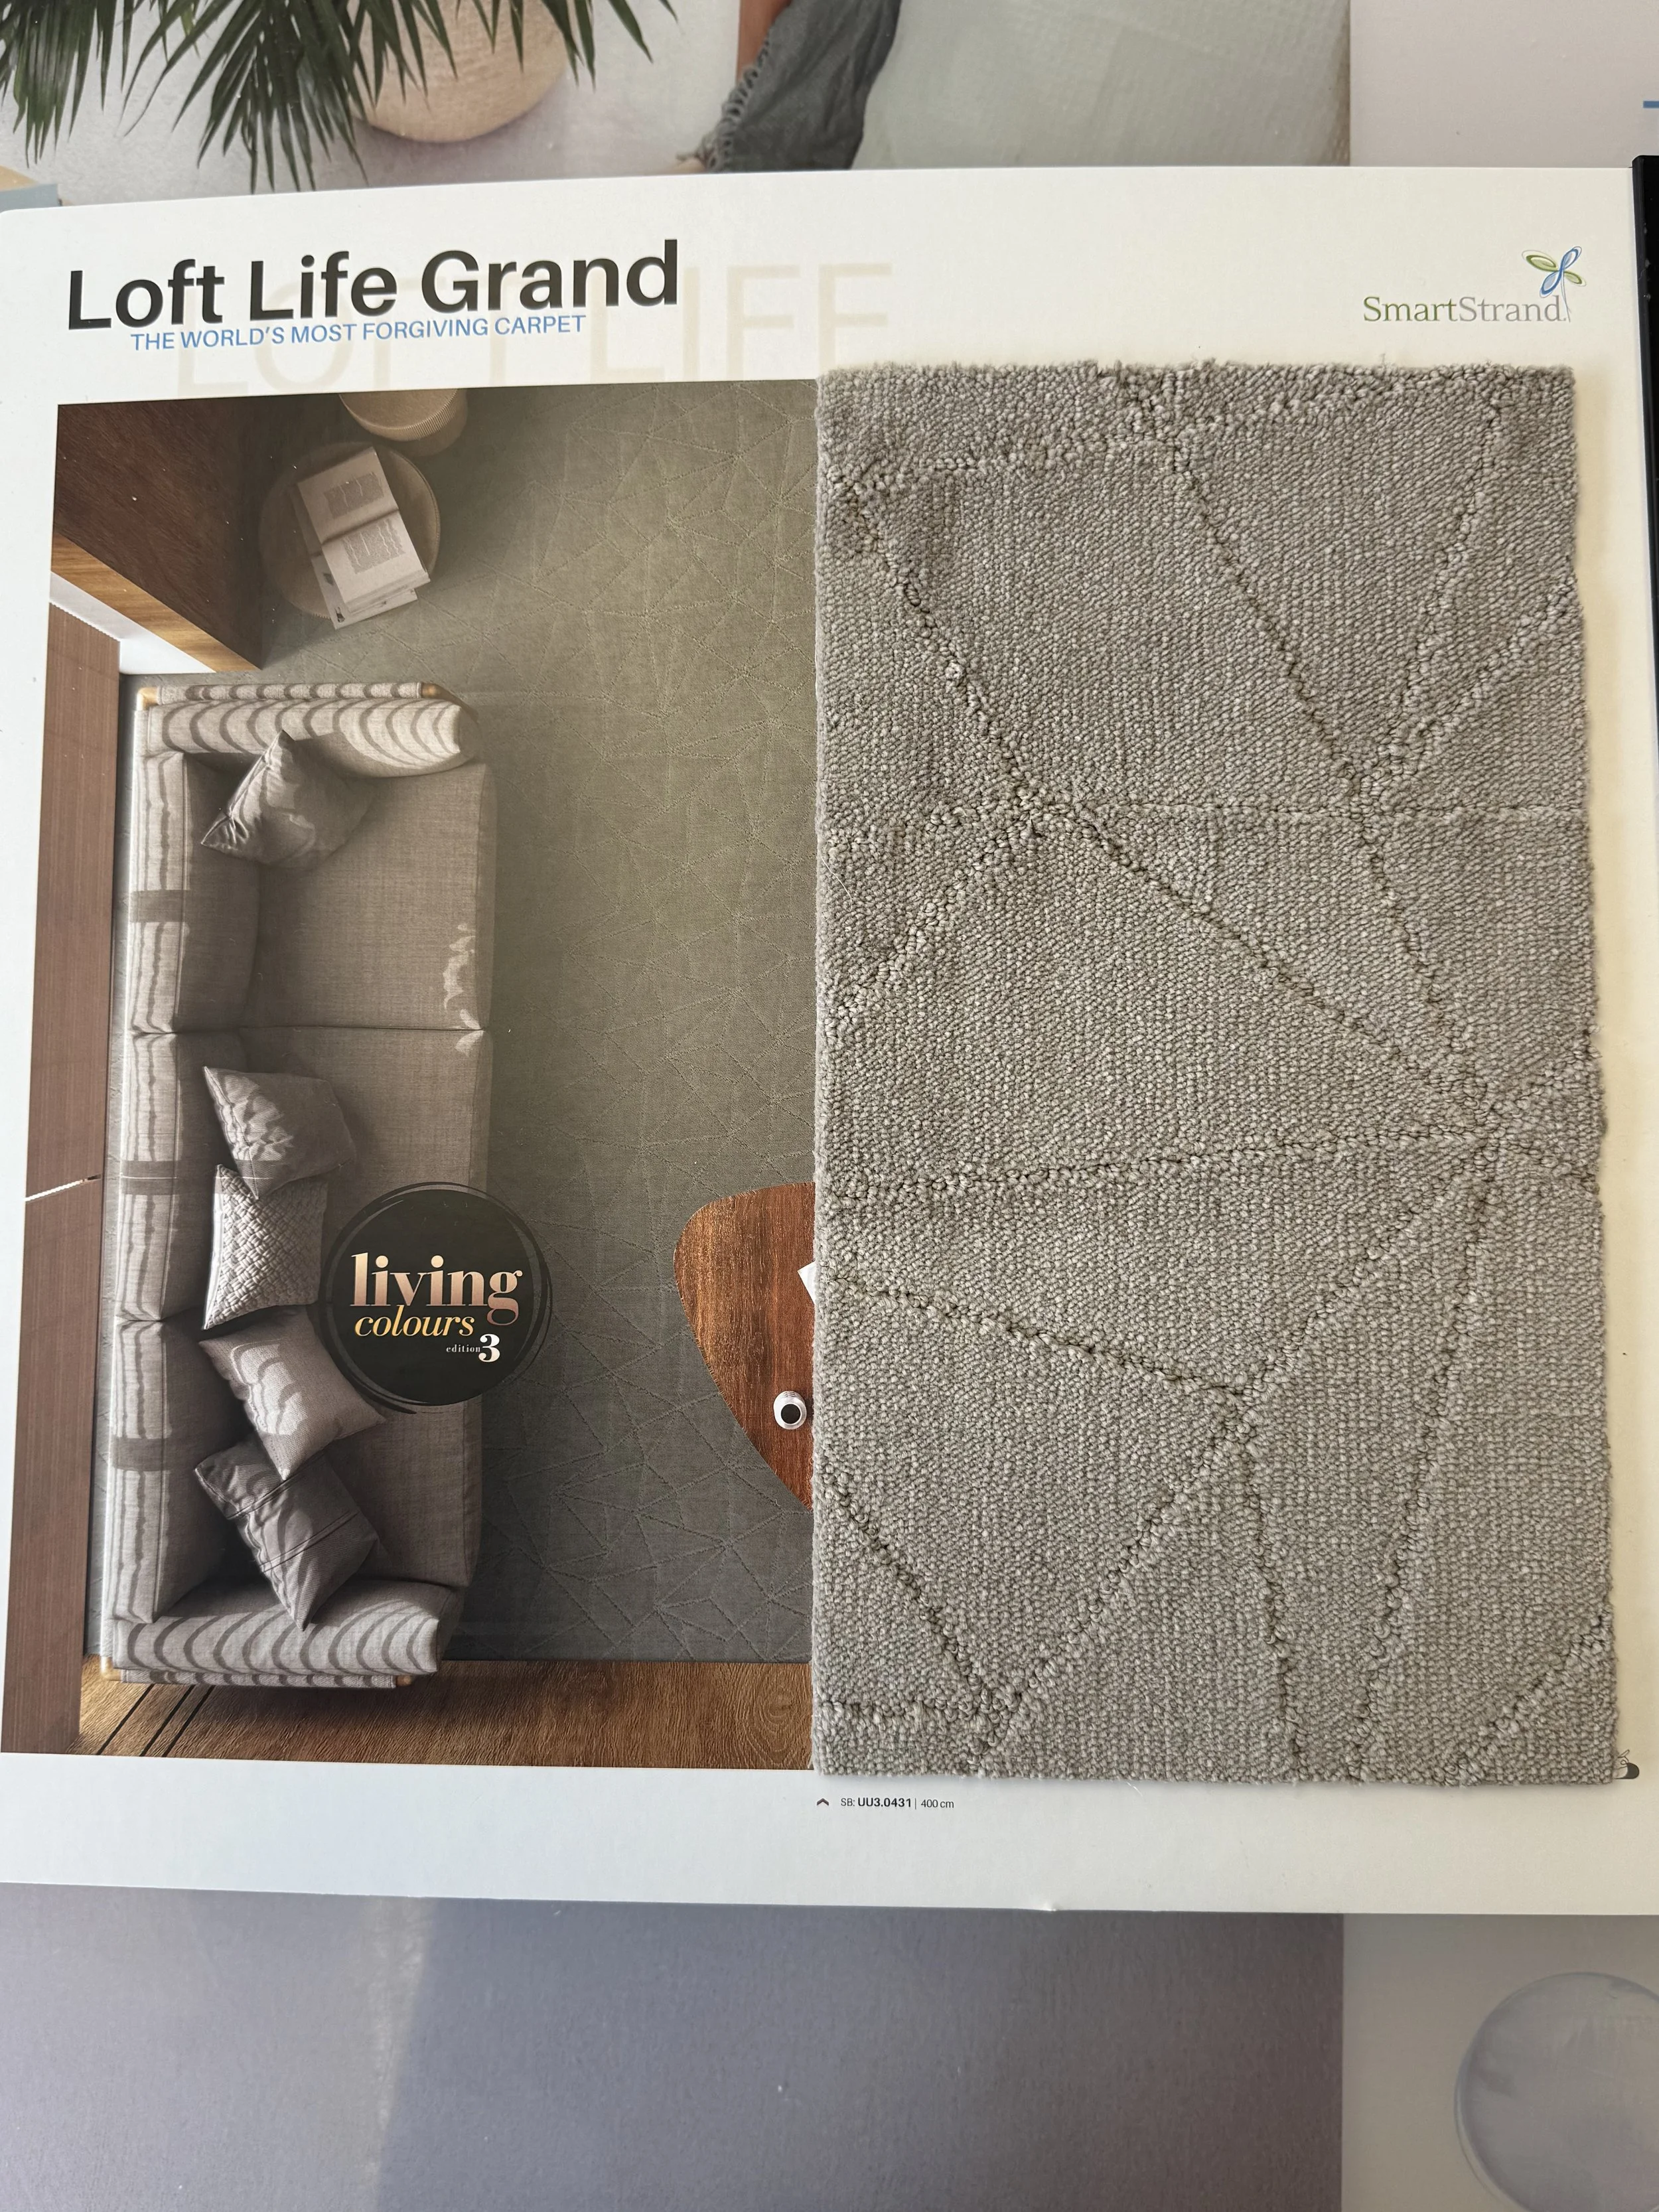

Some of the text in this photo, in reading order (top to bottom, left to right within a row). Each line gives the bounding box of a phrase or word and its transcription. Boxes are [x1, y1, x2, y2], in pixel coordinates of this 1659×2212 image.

[69, 238, 678, 330] Loft Life Grand
[131, 315, 587, 351] THE WORLD'S MOST FORGIVING CARPET
[350, 1252, 523, 1326] living
[354, 1305, 475, 1337] colours
[445, 1333, 500, 1363] edition 3
[840, 1797, 955, 1808] SB: UU3.0431 400 cm
